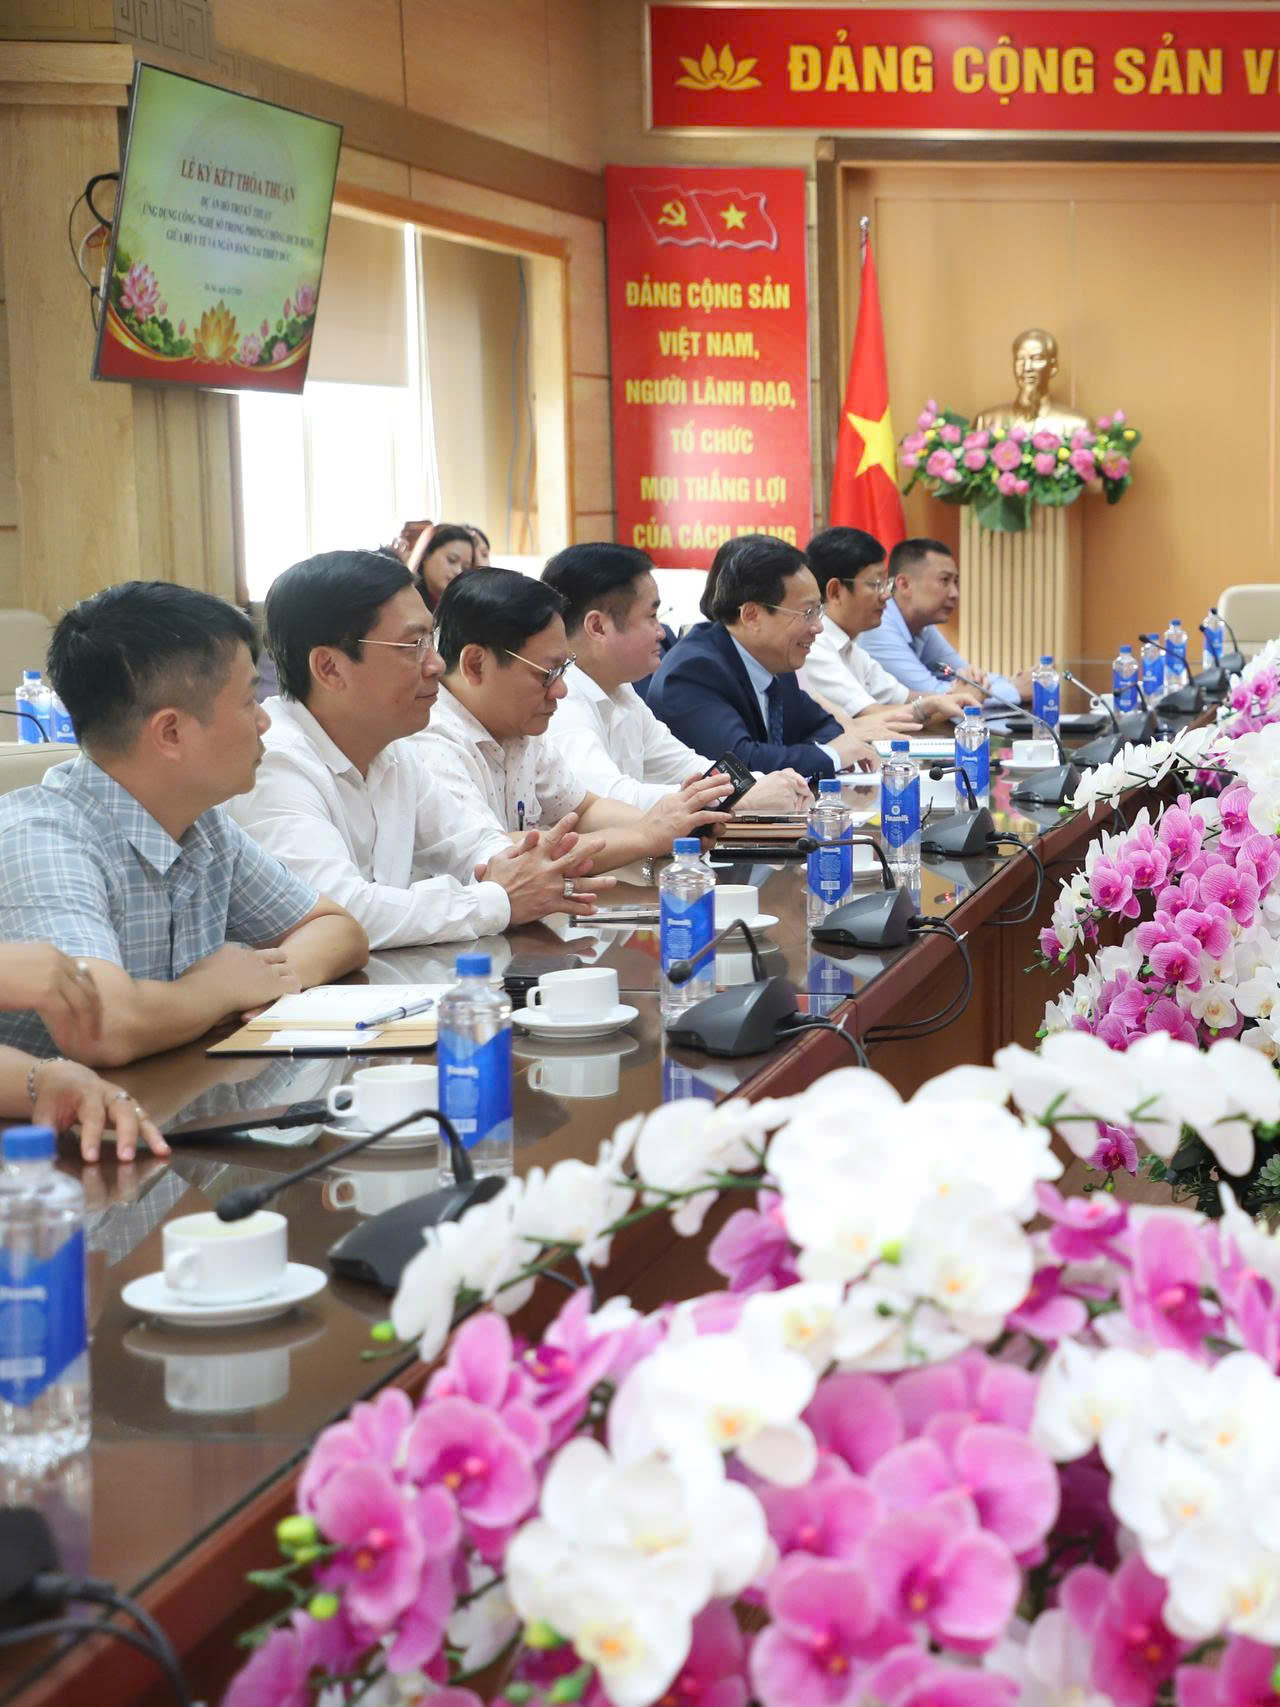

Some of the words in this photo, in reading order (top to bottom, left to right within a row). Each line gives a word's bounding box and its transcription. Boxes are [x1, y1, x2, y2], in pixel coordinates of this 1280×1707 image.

[788, 29, 934, 94] ĐẢNG
[952, 35, 1095, 104] CỘNG
[1114, 32, 1223, 96] SẢN
[625, 273, 682, 308] ĐẢNG
[687, 277, 745, 313] CỘNG
[748, 274, 791, 309] SẢN
[658, 325, 701, 362] VIỆT
[706, 331, 761, 360] NAM,
[625, 375, 688, 405] NGƯỜI
[692, 375, 745, 406] LÃNH
[750, 381, 797, 411] ĐẠO,
[670, 421, 695, 454] TỔ
[700, 424, 754, 454] CHỨC
[640, 475, 680, 506] MỌI
[685, 467, 751, 503] THẮNG
[755, 474, 786, 507] LỢI
[632, 516, 673, 550] CỦA
